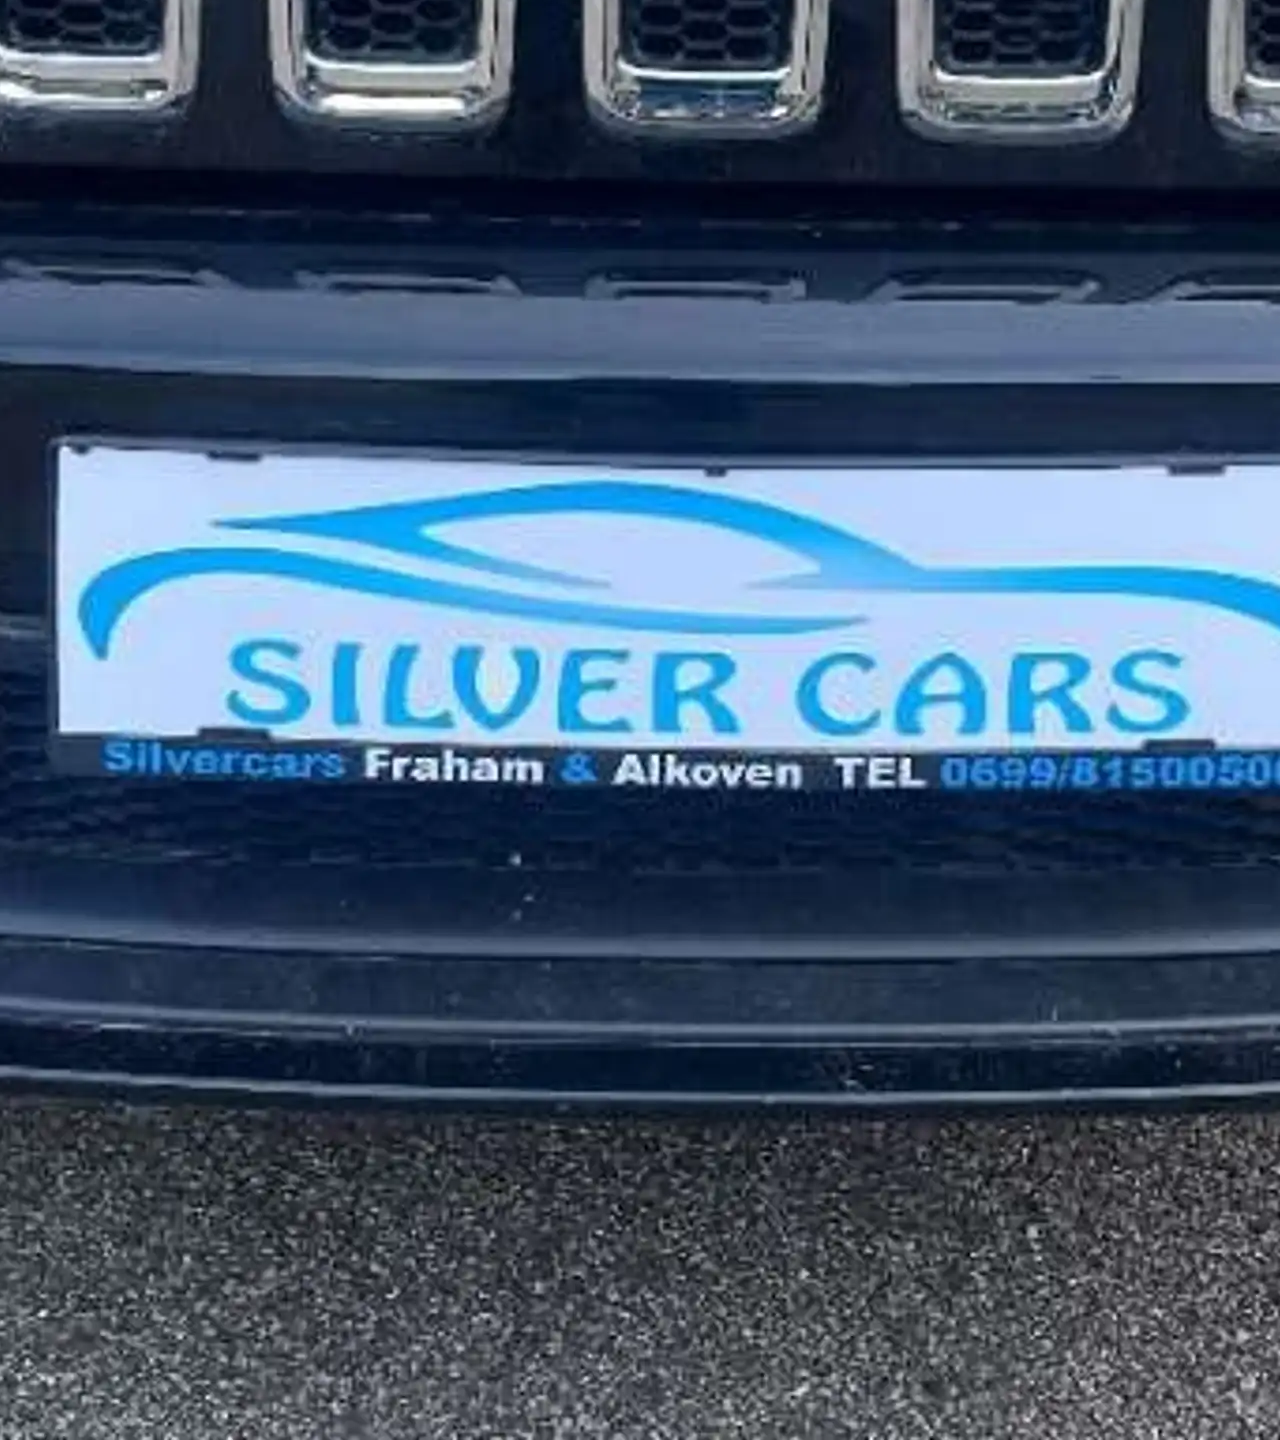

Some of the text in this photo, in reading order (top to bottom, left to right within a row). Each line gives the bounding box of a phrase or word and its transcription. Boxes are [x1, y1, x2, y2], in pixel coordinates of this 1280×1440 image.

[227, 637, 1191, 737] SILVER CARS
[103, 740, 347, 782] Silvercars
[363, 747, 544, 785] Fraham
[560, 750, 597, 785] &
[611, 752, 803, 790] Alkoven
[833, 755, 927, 790] TEL
